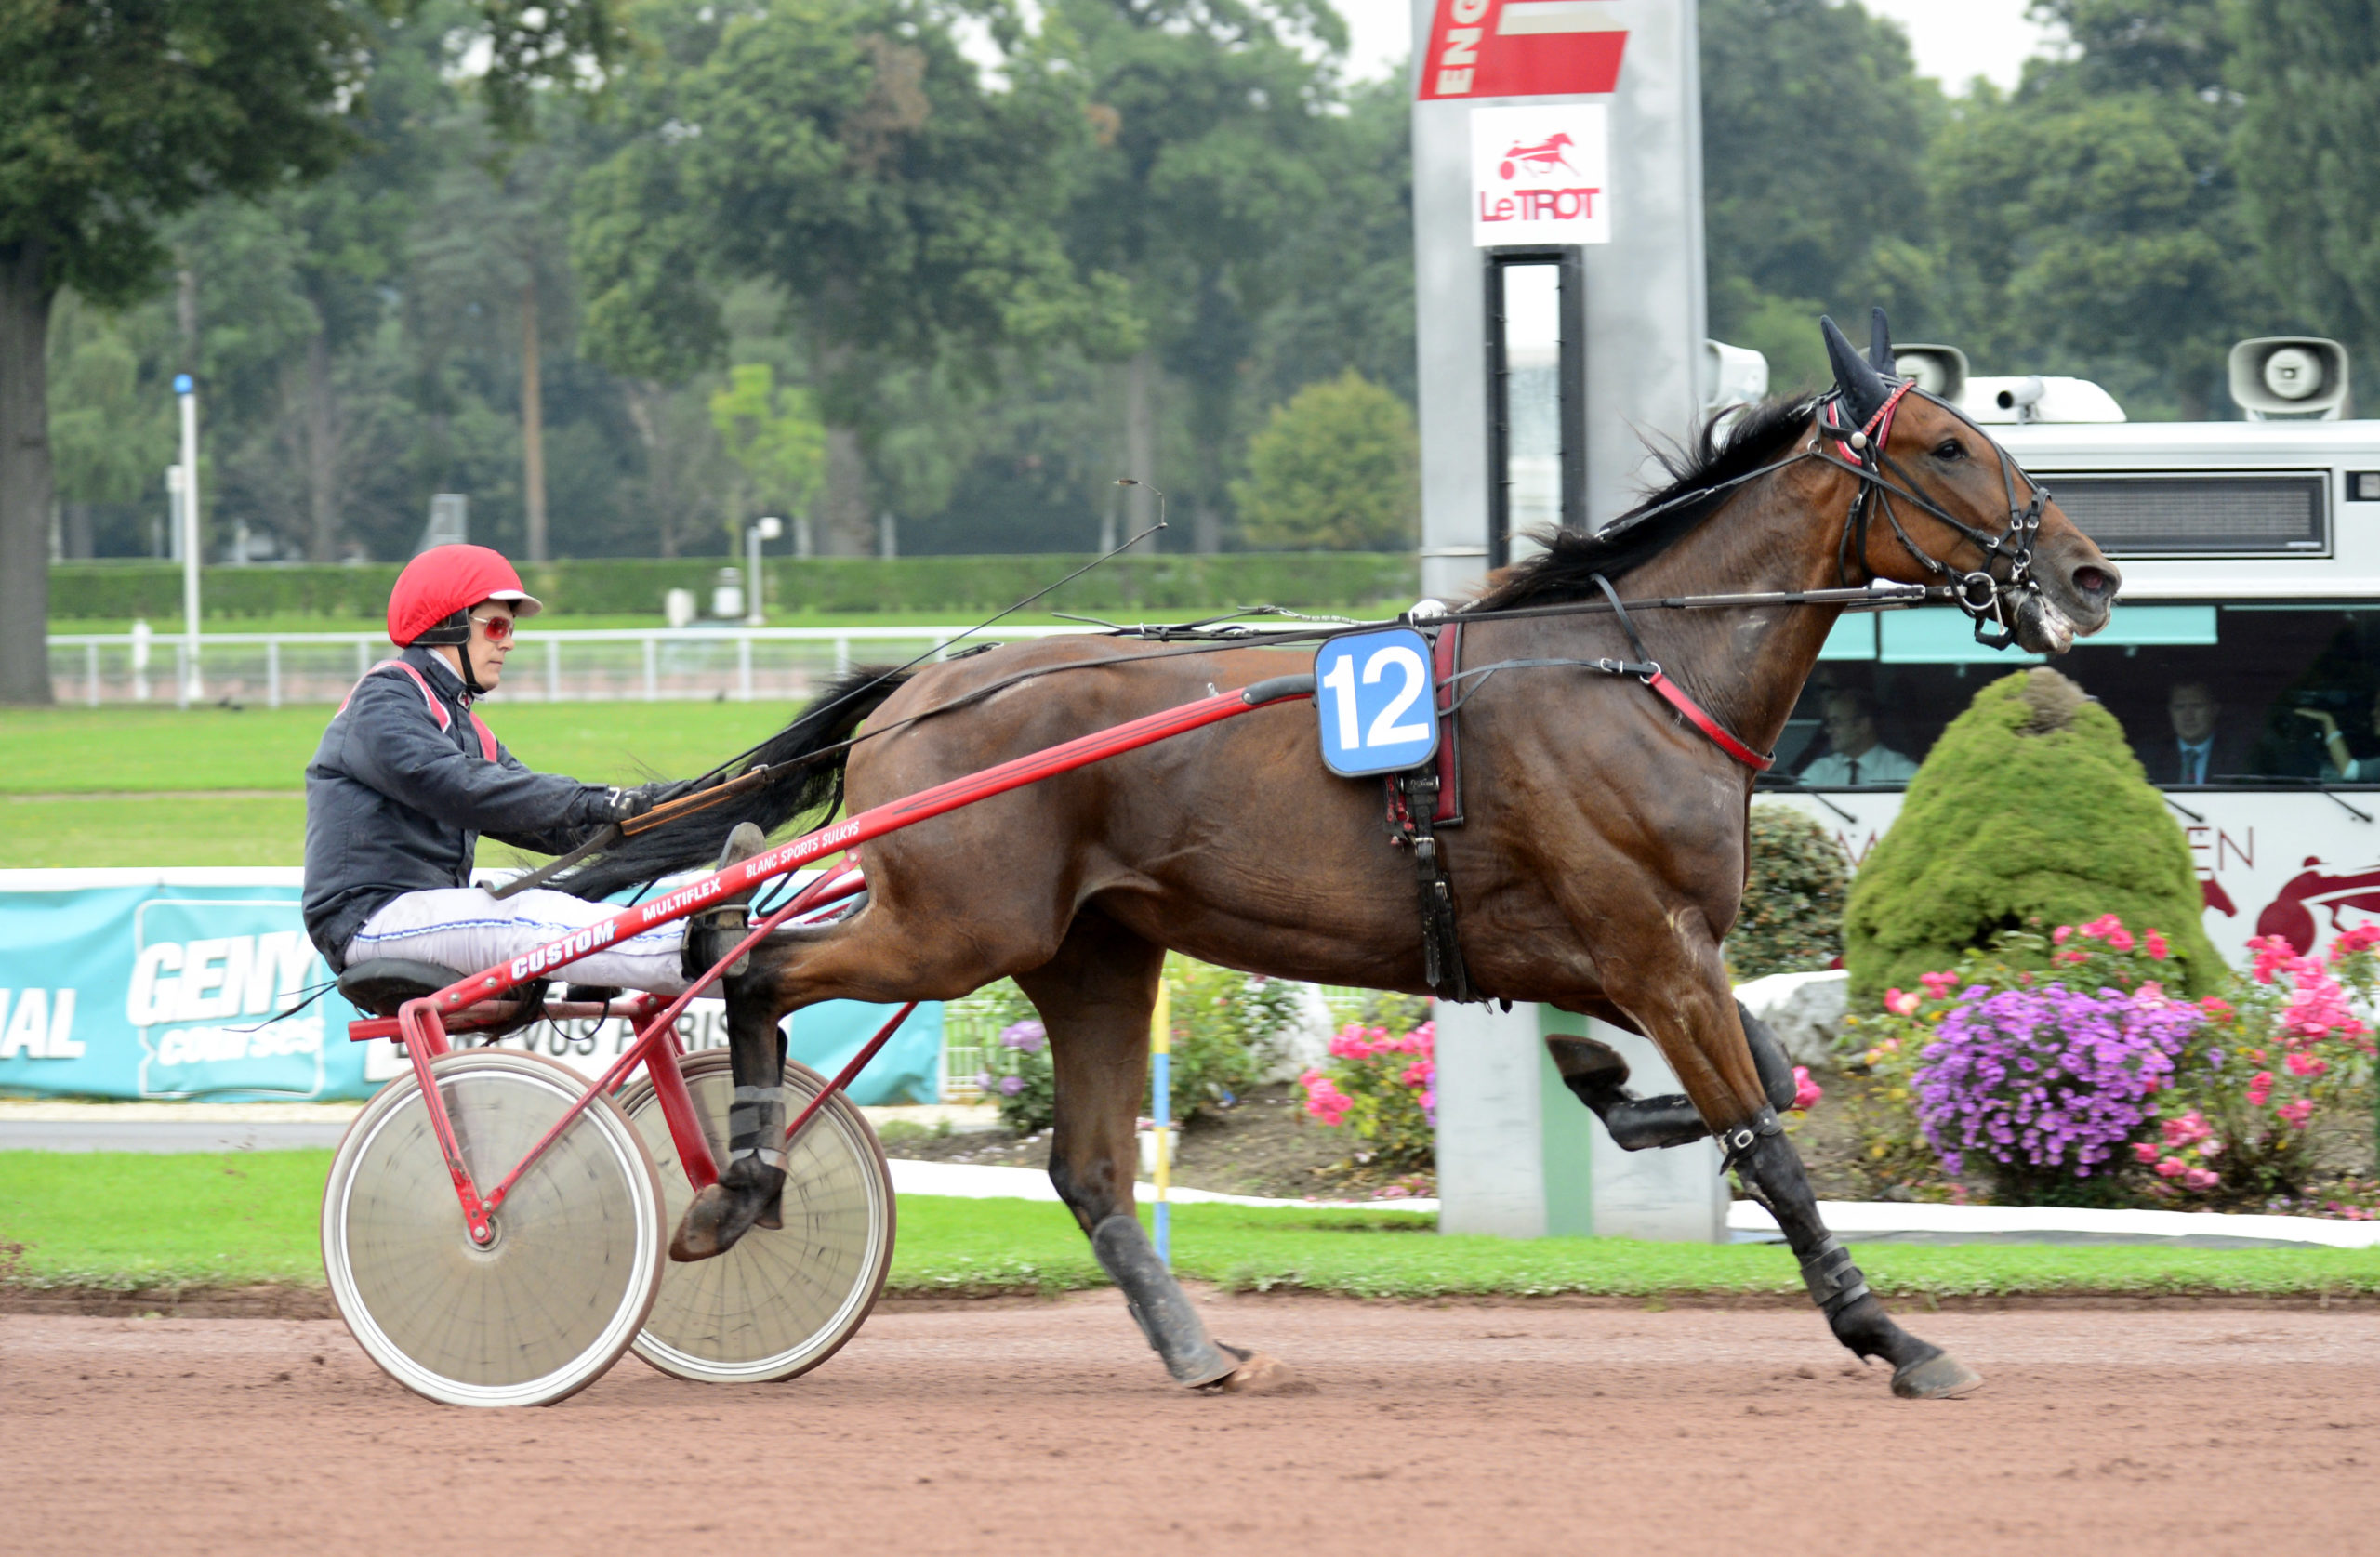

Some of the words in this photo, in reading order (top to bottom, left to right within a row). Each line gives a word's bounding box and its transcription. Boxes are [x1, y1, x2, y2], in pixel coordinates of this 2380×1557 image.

[1323, 646, 1430, 751] 12
[511, 919, 615, 980] CUSTOM
[642, 877, 721, 923] MULTIFLEX
[746, 853, 778, 878] BLANC
[780, 837, 819, 864] SPORTS
[822, 821, 860, 848] SULKYS
[126, 930, 319, 1026] GENY
[615, 1010, 729, 1054] PRIS
